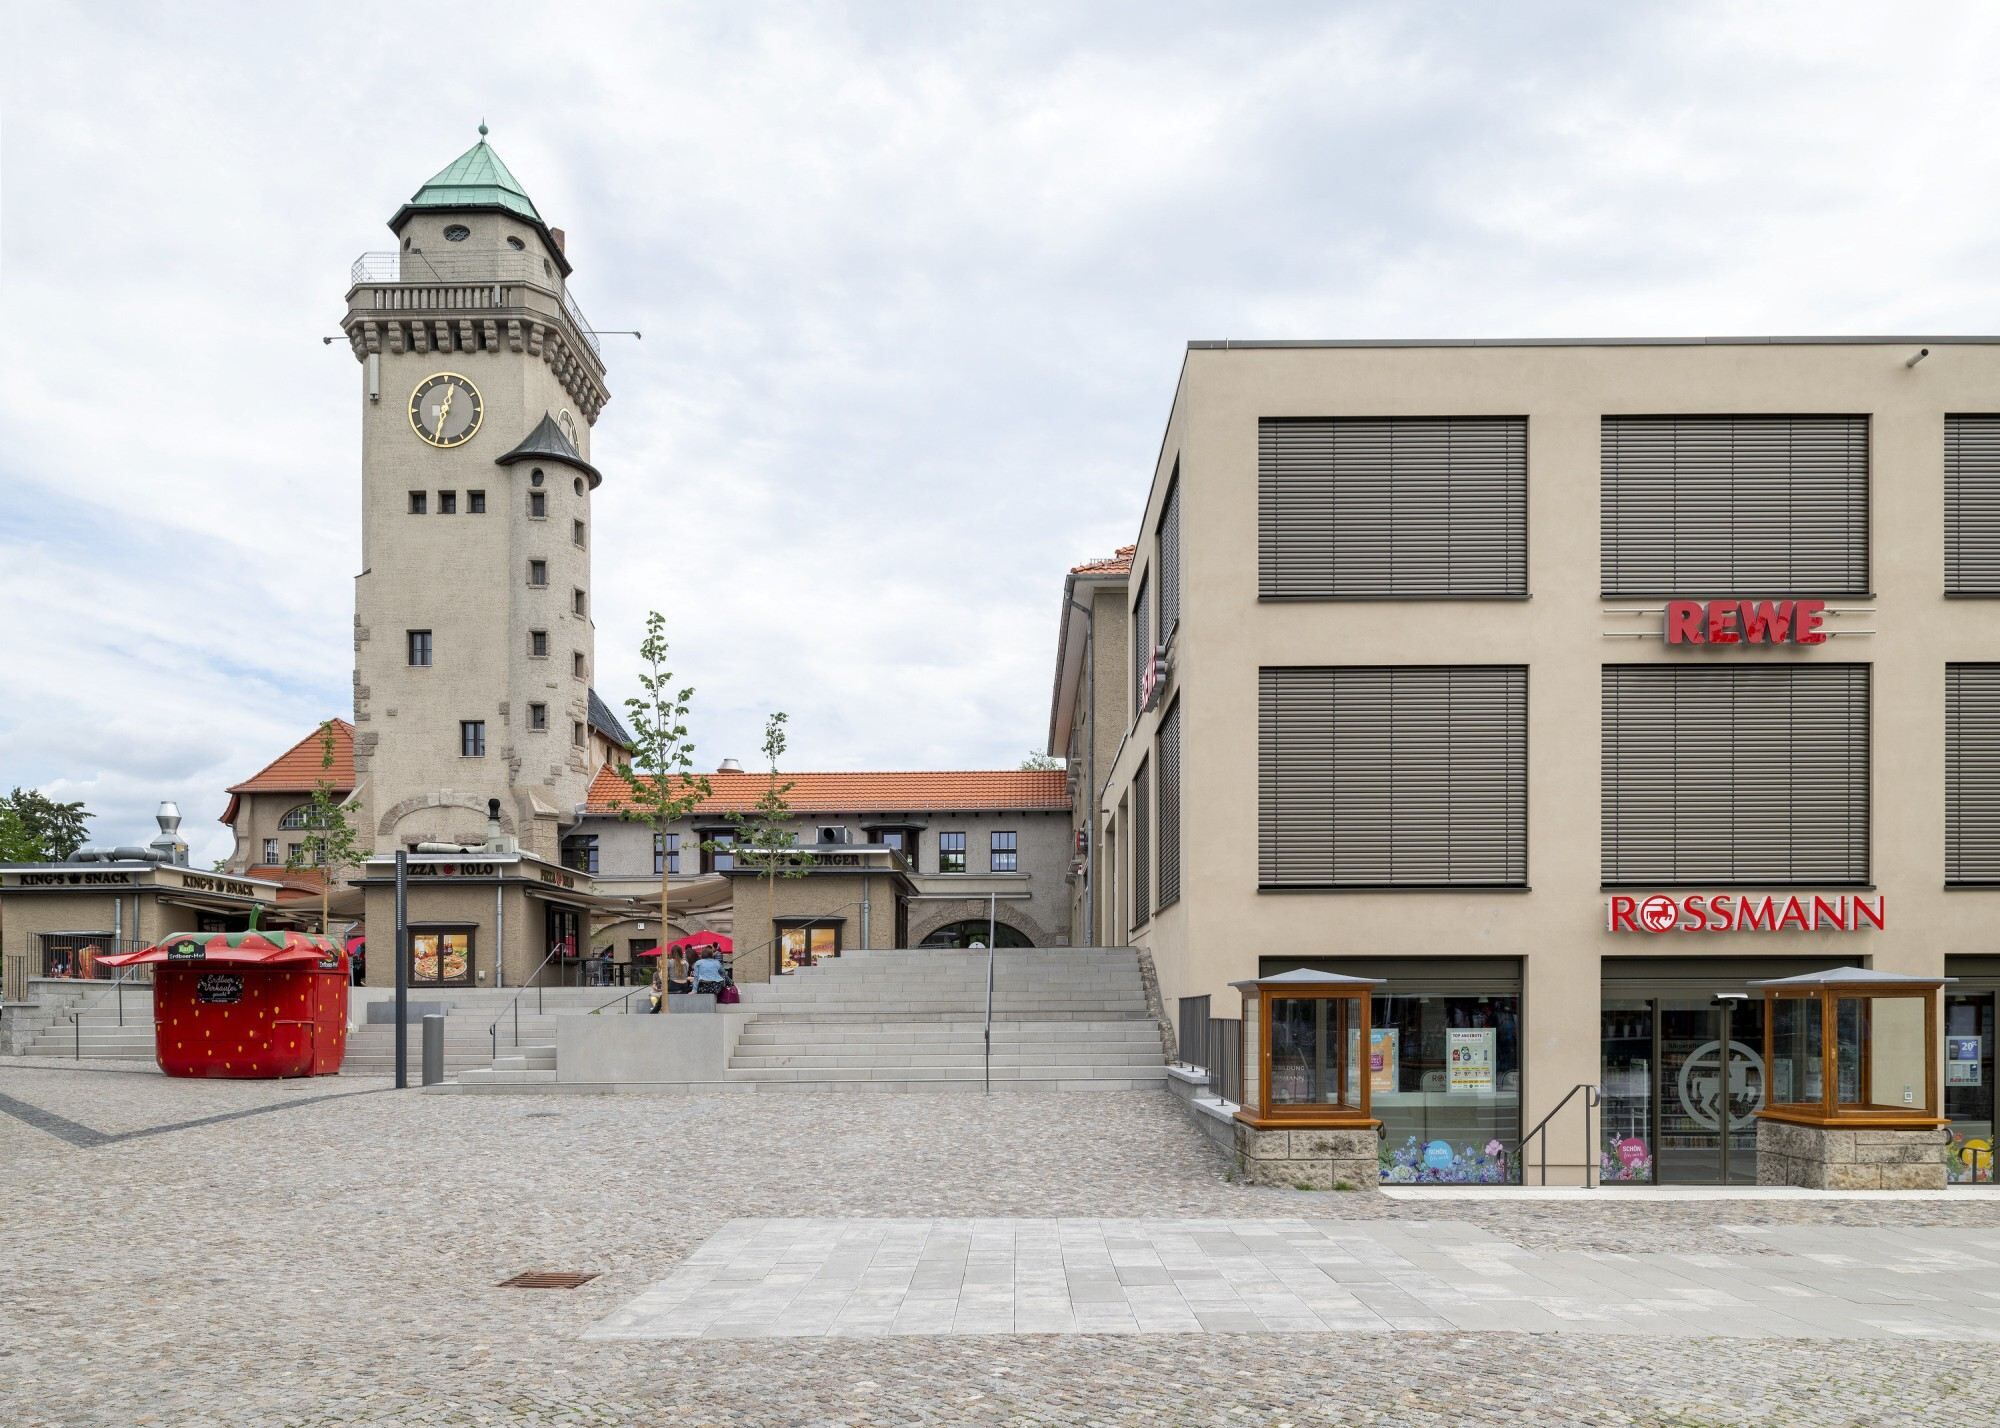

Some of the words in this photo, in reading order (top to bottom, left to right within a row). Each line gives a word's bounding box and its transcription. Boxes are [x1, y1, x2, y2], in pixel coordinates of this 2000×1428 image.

[1665, 600, 1827, 645] REWE
[407, 863, 438, 875] IZZA
[460, 863, 494, 875] IOLO
[815, 854, 860, 866] URGER
[20, 873, 65, 886] KING'S
[84, 872, 130, 884] SNACK
[182, 874, 214, 891] KING'S
[226, 880, 255, 897] SNACK
[1608, 894, 1886, 934] ROSSMANN
